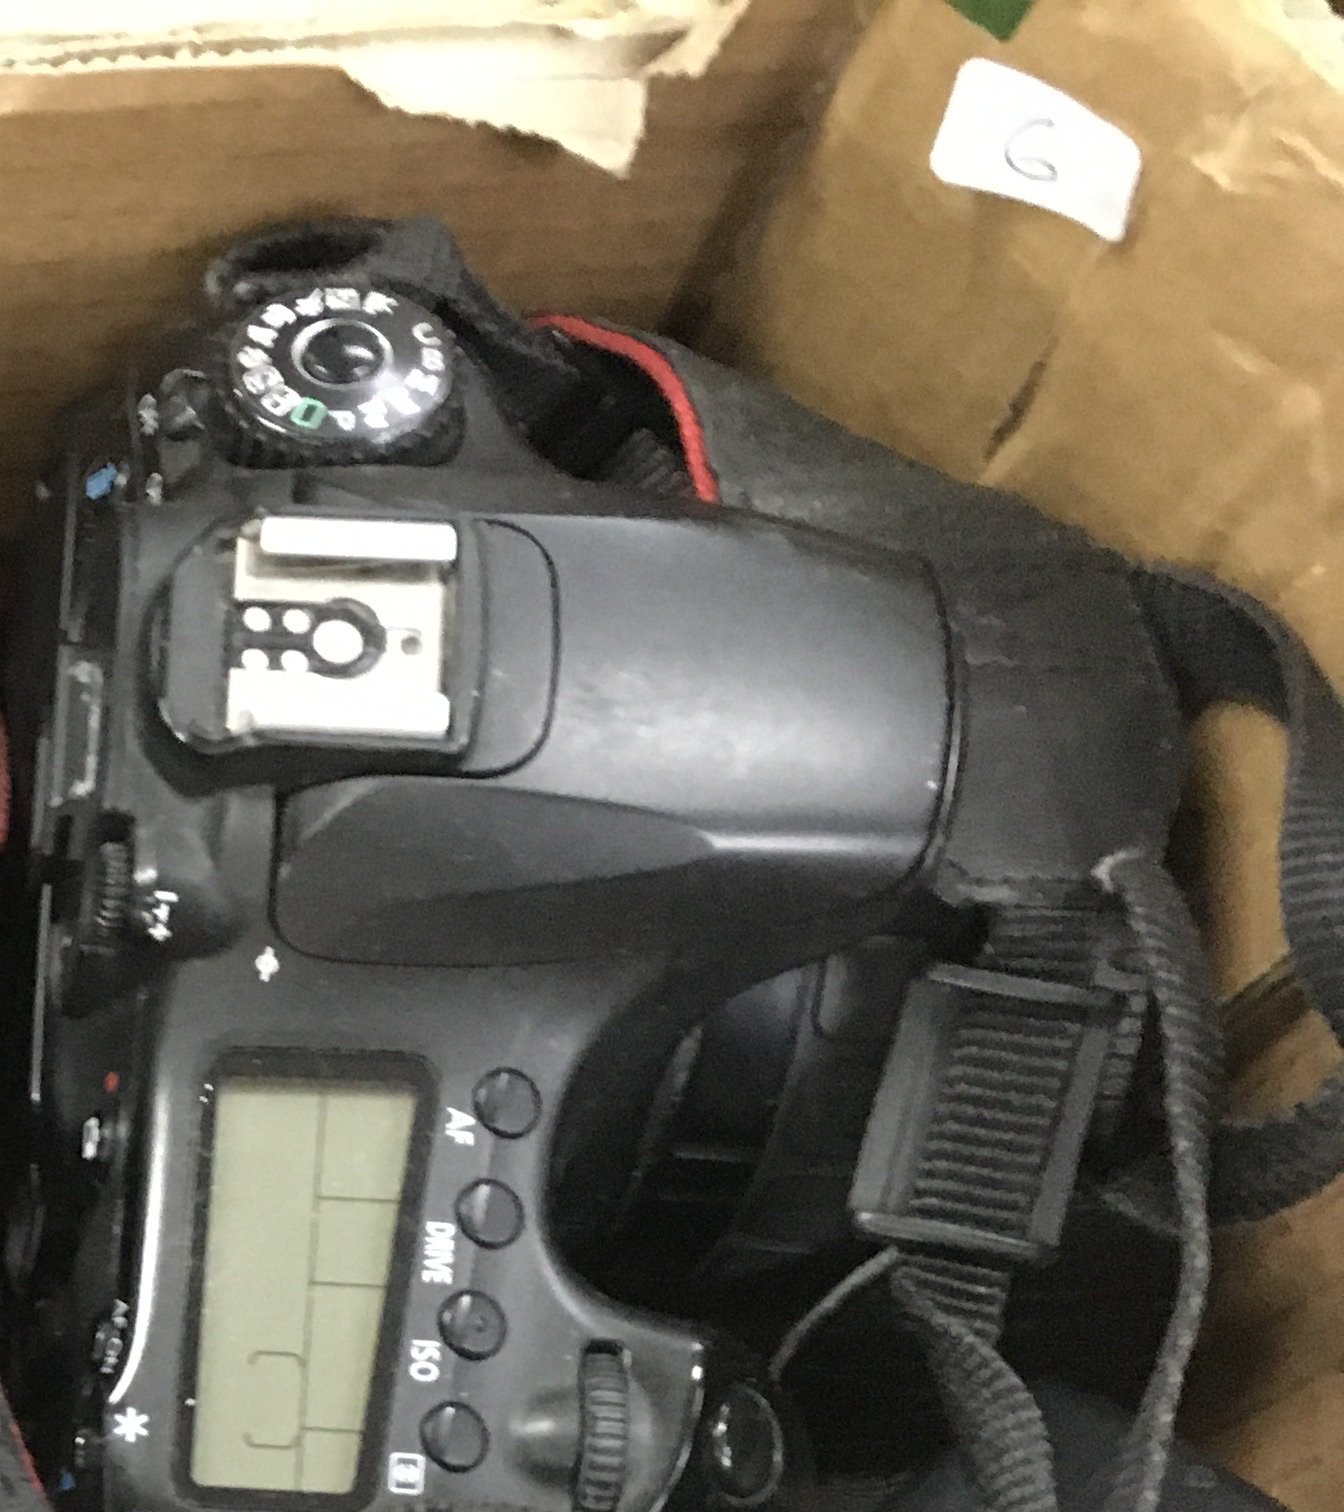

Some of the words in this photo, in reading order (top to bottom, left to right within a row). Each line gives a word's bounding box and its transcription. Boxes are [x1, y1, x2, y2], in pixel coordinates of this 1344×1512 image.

[444, 1106, 476, 1148] AF
[421, 1220, 457, 1286] DRIVE
[407, 1337, 440, 1383] ISO
